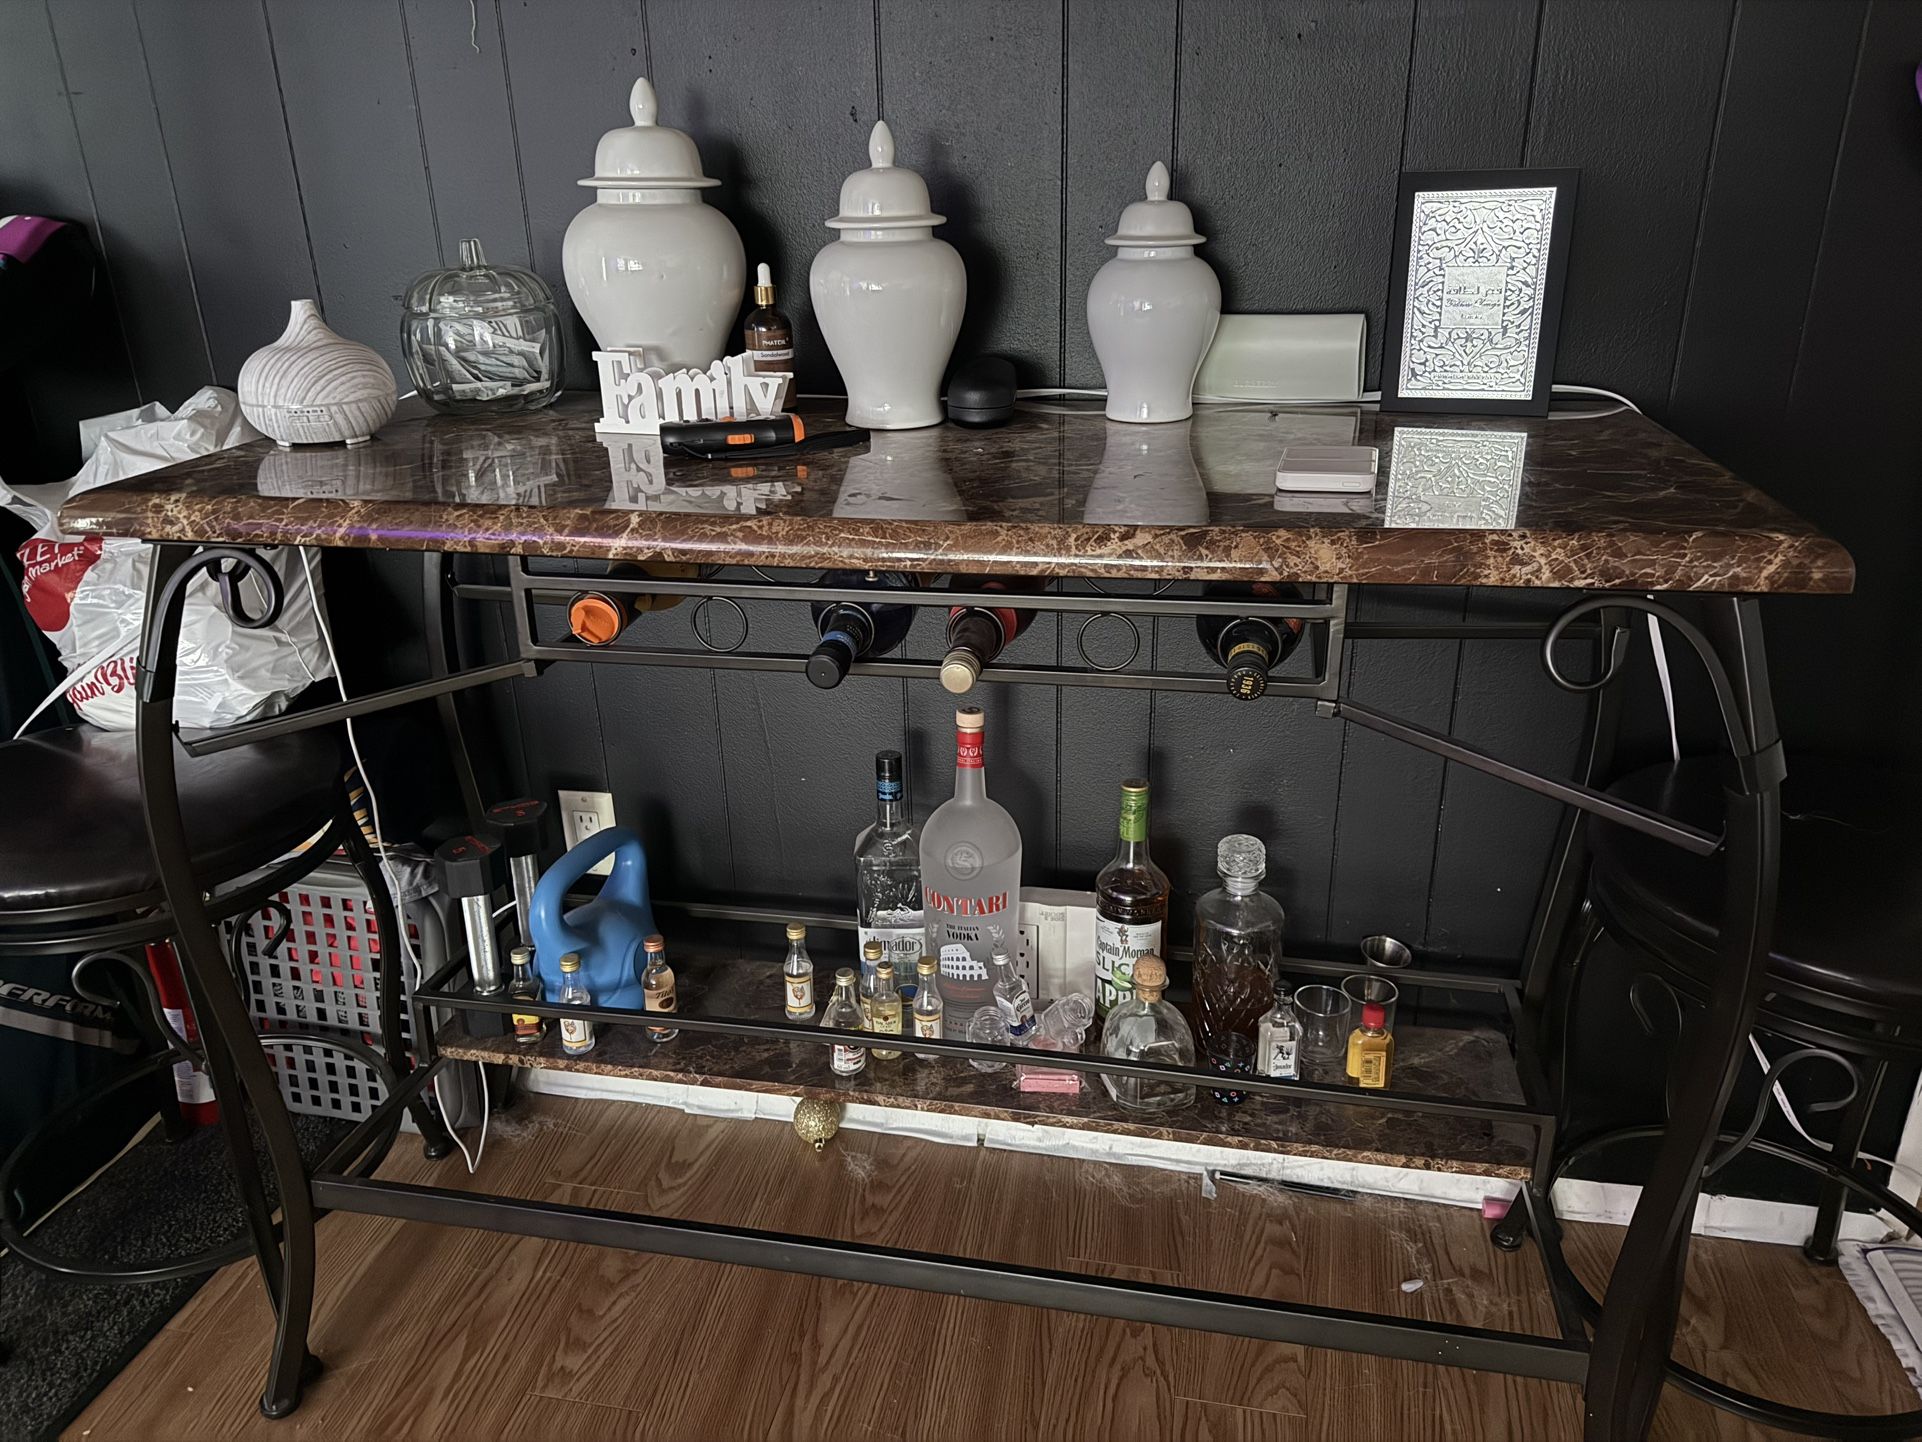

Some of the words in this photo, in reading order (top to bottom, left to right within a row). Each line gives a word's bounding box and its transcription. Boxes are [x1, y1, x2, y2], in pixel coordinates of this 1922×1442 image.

[592, 348, 793, 432] Family
[1240, 676, 1254, 694] 1936
[924, 886, 1009, 917] CONTARI
[946, 929, 980, 942] VODKA
[1096, 951, 1136, 976] SLIC
[1096, 978, 1137, 1008] APP
